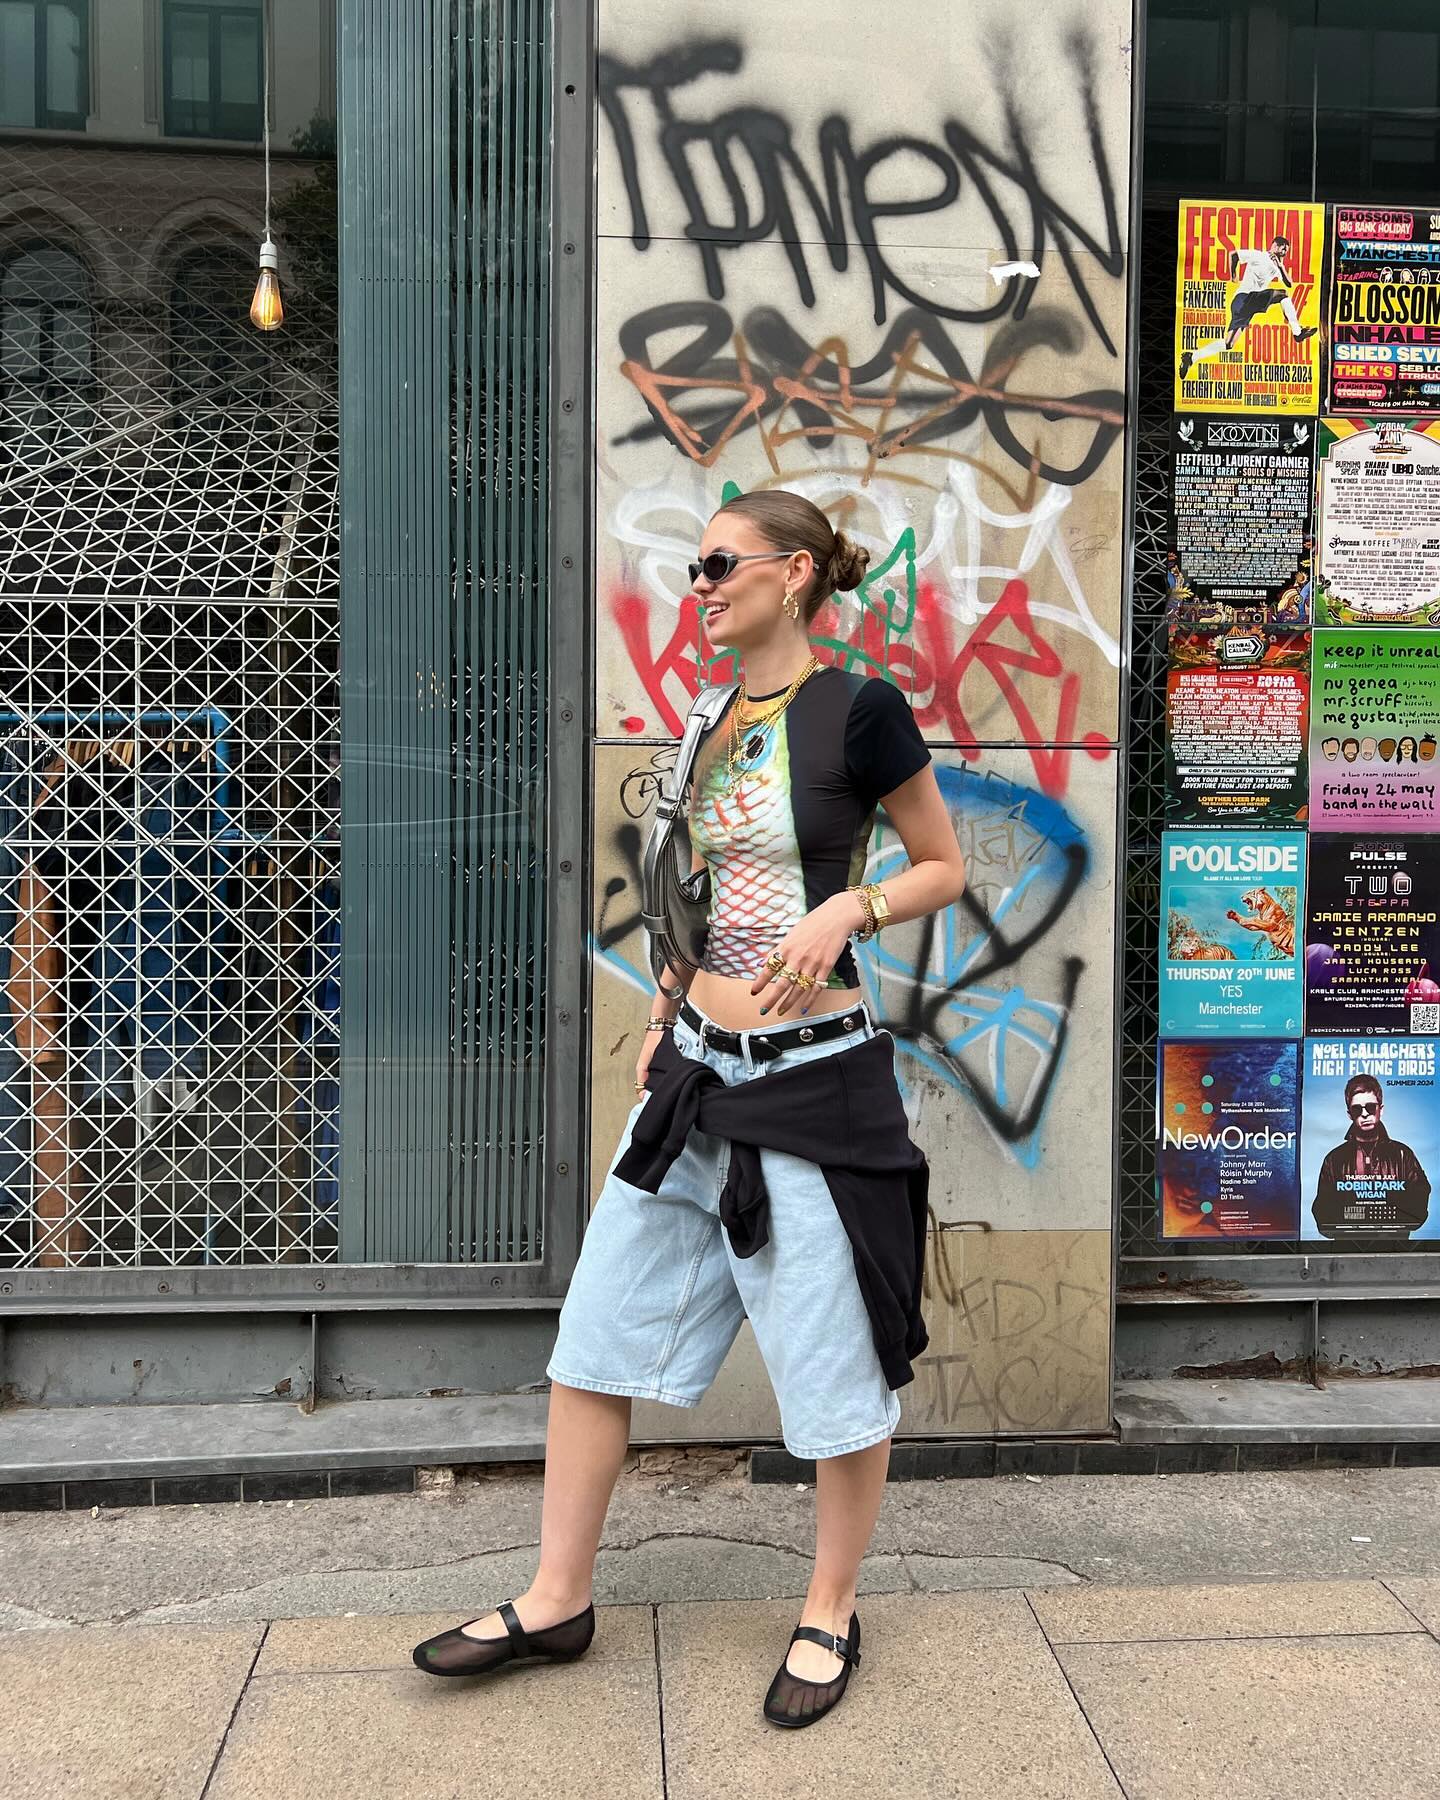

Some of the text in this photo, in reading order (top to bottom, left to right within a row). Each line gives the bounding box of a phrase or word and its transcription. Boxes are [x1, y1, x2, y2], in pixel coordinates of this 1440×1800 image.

[1340, 212, 1411, 223] BLOSSOMS
[1340, 221, 1410, 234] BIG BANK HOLIDAY
[1184, 206, 1314, 283] FESTIVAL
[1347, 242, 1428, 252] WYTHENSHAWE
[1337, 271, 1378, 281] STARRING
[1184, 281, 1226, 291] FULL VENUE
[1184, 290, 1226, 309] FANZONE
[1182, 326, 1226, 350] FREE ENTRY
[1244, 324, 1312, 364] FOOTBALL
[1337, 345, 1440, 362] SHED SEV
[1245, 365, 1312, 383] UEFA EUROS 2024
[1335, 365, 1393, 377] THE K'S
[1399, 365, 1424, 373] SEB
[1182, 381, 1242, 399] FREIGHT ISLAND
[1208, 426, 1279, 442] MOOVIN
[1378, 432, 1403, 444] LAND
[1176, 453, 1309, 468] LEFTFIELD LAURENT GARNIER
[1175, 466, 1309, 478] SAMPA THE GREAT SOULS OF MISCHIEF
[1391, 463, 1414, 475] UB40
[1323, 644, 1440, 660] keep it unreal
[1324, 679, 1343, 690] nu
[1348, 678, 1398, 695] genea
[1323, 713, 1346, 724] me
[1350, 711, 1397, 730] gusta
[1323, 783, 1435, 798] friday 24 may
[1323, 799, 1358, 810] band
[1379, 800, 1398, 810] the
[1400, 800, 1435, 810] wall
[1169, 845, 1299, 872] POOLSIDE
[1349, 852, 1408, 860] PULSE
[1344, 876, 1412, 895] TWO
[1345, 898, 1409, 907] STEPPA
[1312, 912, 1437, 922] JAMIE ARAMAYO
[1332, 927, 1420, 937] JENTZEN
[1333, 944, 1419, 952] PADDY LEE
[1166, 968, 1295, 980] THURSDAY 20TH JUNE
[1220, 985, 1243, 998] YES
[1199, 1002, 1263, 1015] Manchester
[1313, 1043, 1435, 1060] NOEL GALLAGHER'S
[1312, 1060, 1435, 1076] HIGH FLYING BIRDS
[1162, 1125, 1296, 1150] NewOrder
[1220, 1160, 1266, 1169] Johnny Marr
[1244, 1169, 1272, 1178] Murphy
[1336, 1181, 1406, 1191] ROBIN PARK
[1355, 1191, 1386, 1199] WIGAN
